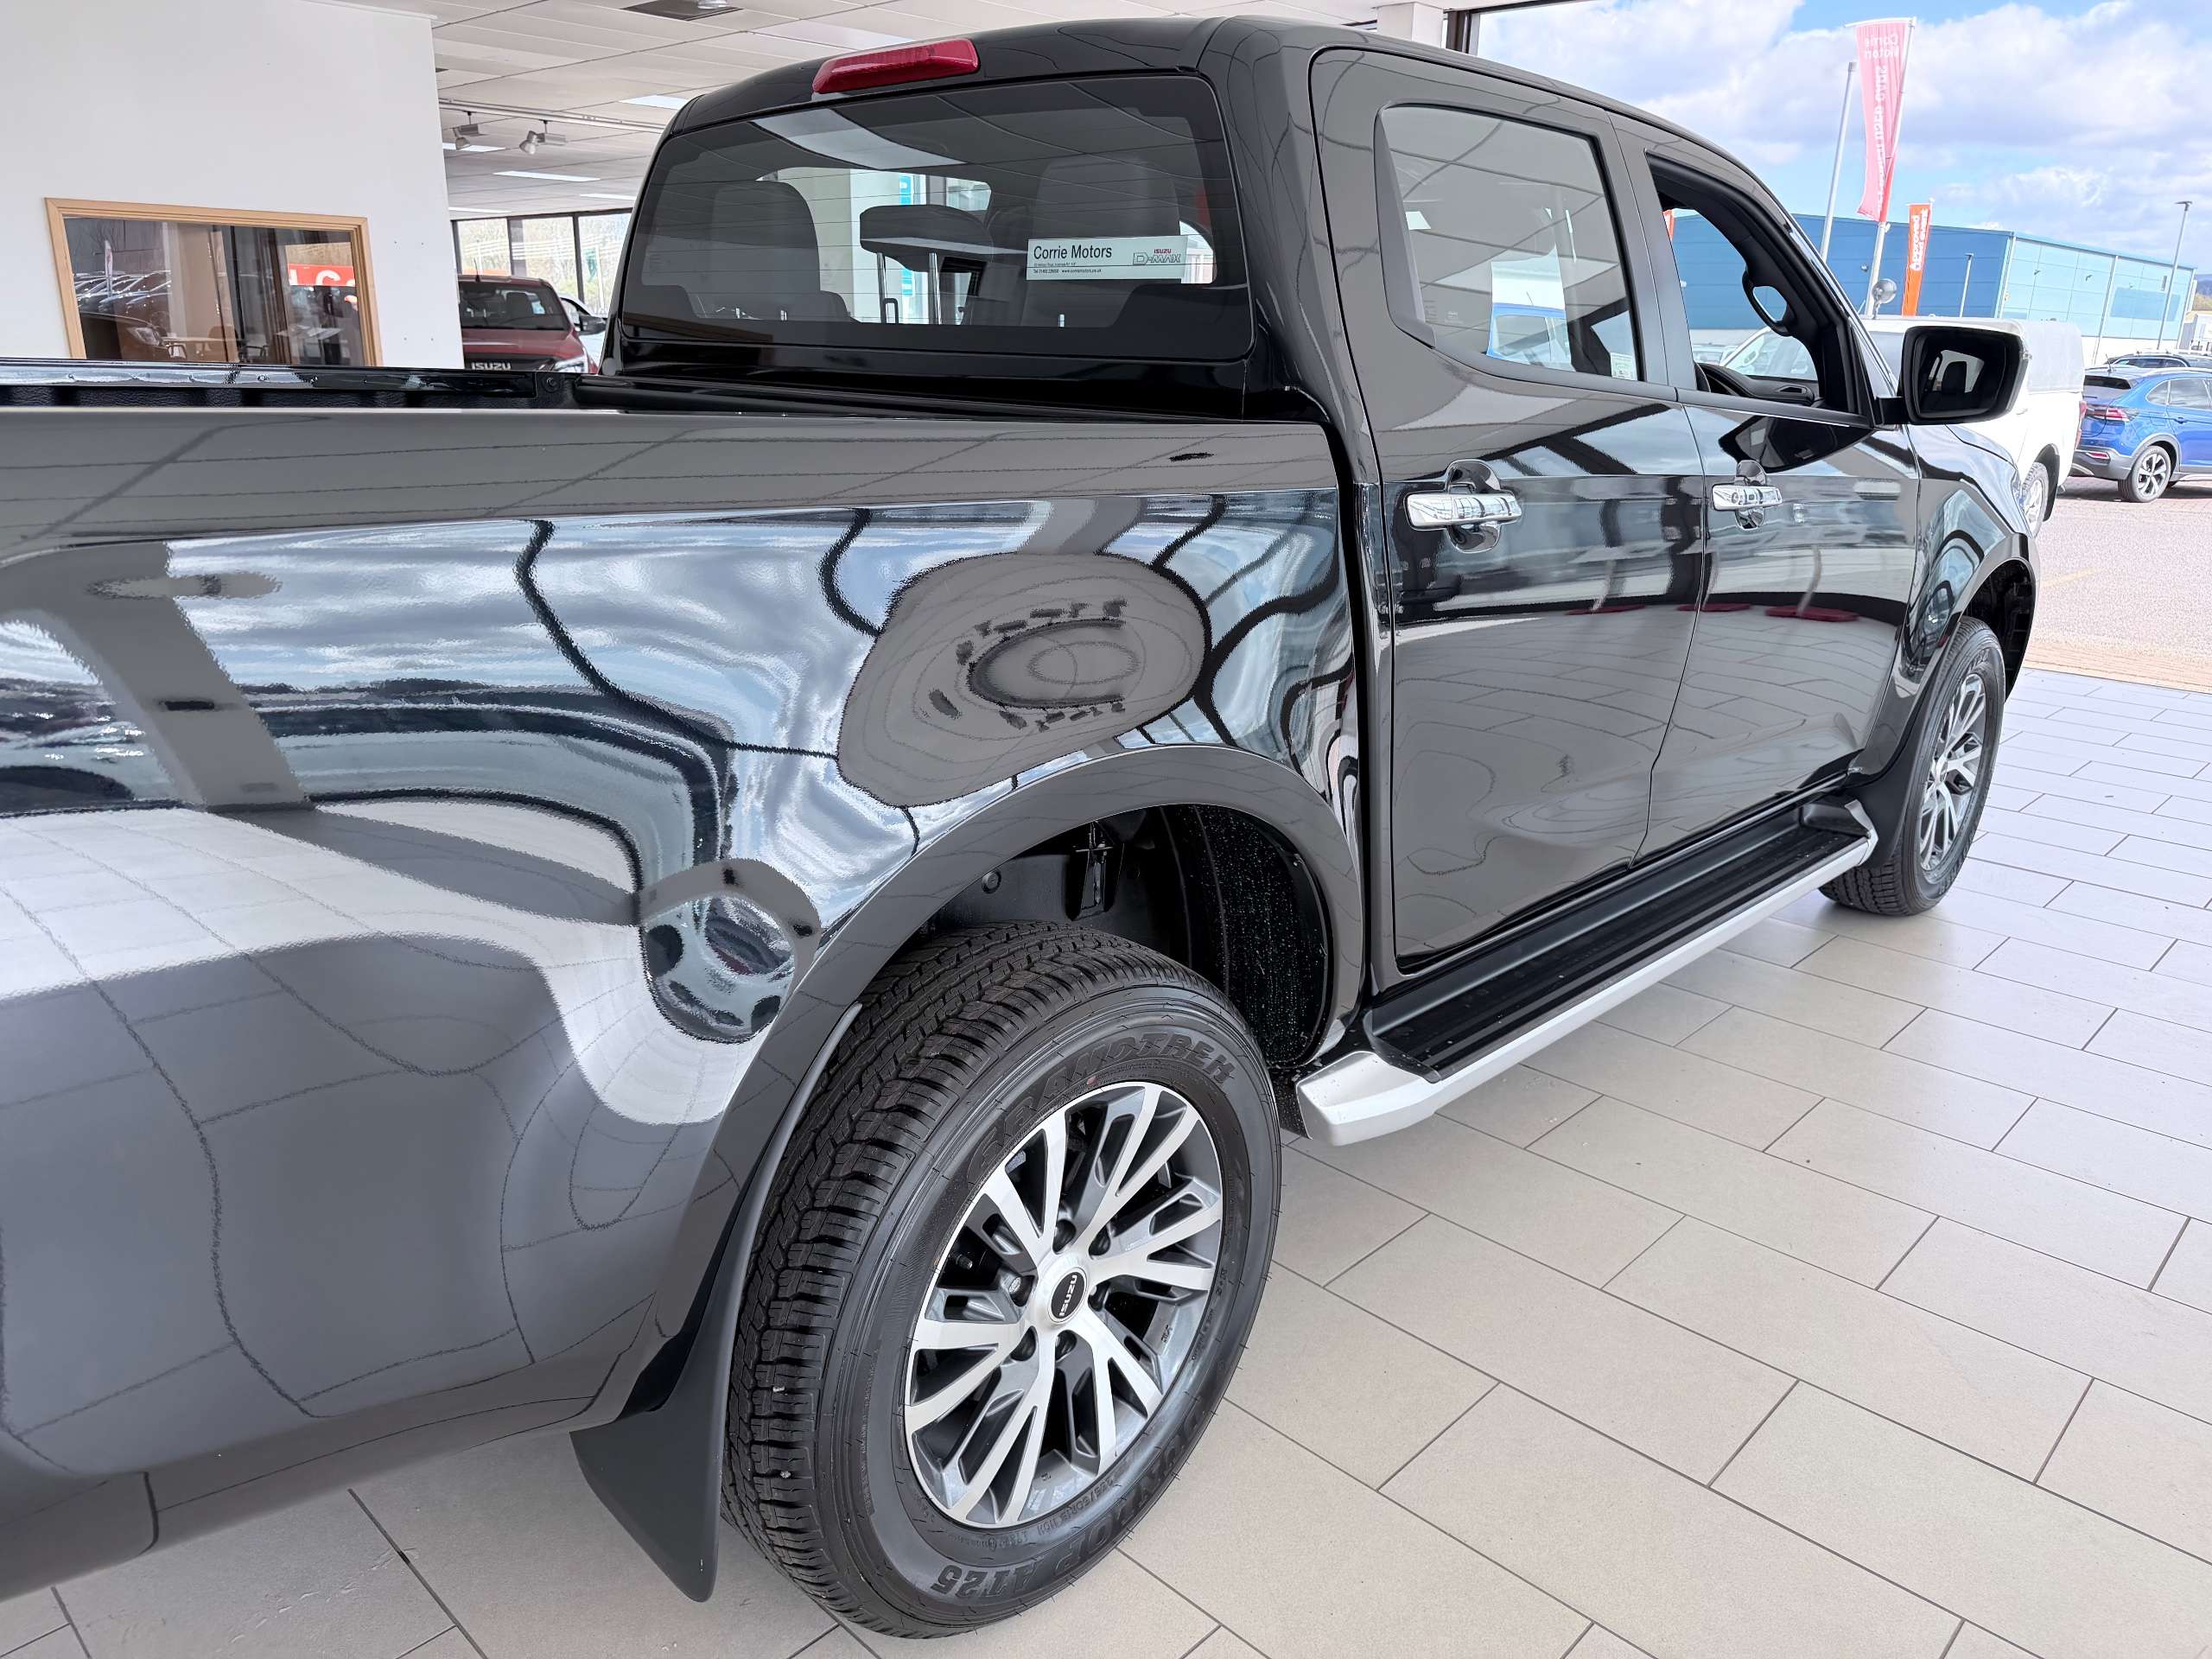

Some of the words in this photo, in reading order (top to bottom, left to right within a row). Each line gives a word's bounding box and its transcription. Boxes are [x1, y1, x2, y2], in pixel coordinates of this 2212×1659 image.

[1033, 245, 1068, 259] Corrie
[1071, 245, 1112, 259] Motors
[1133, 252, 1181, 265] D-MAX
[472, 362, 512, 372] ISUZU
[1058, 1274, 1077, 1317] ISUZU
